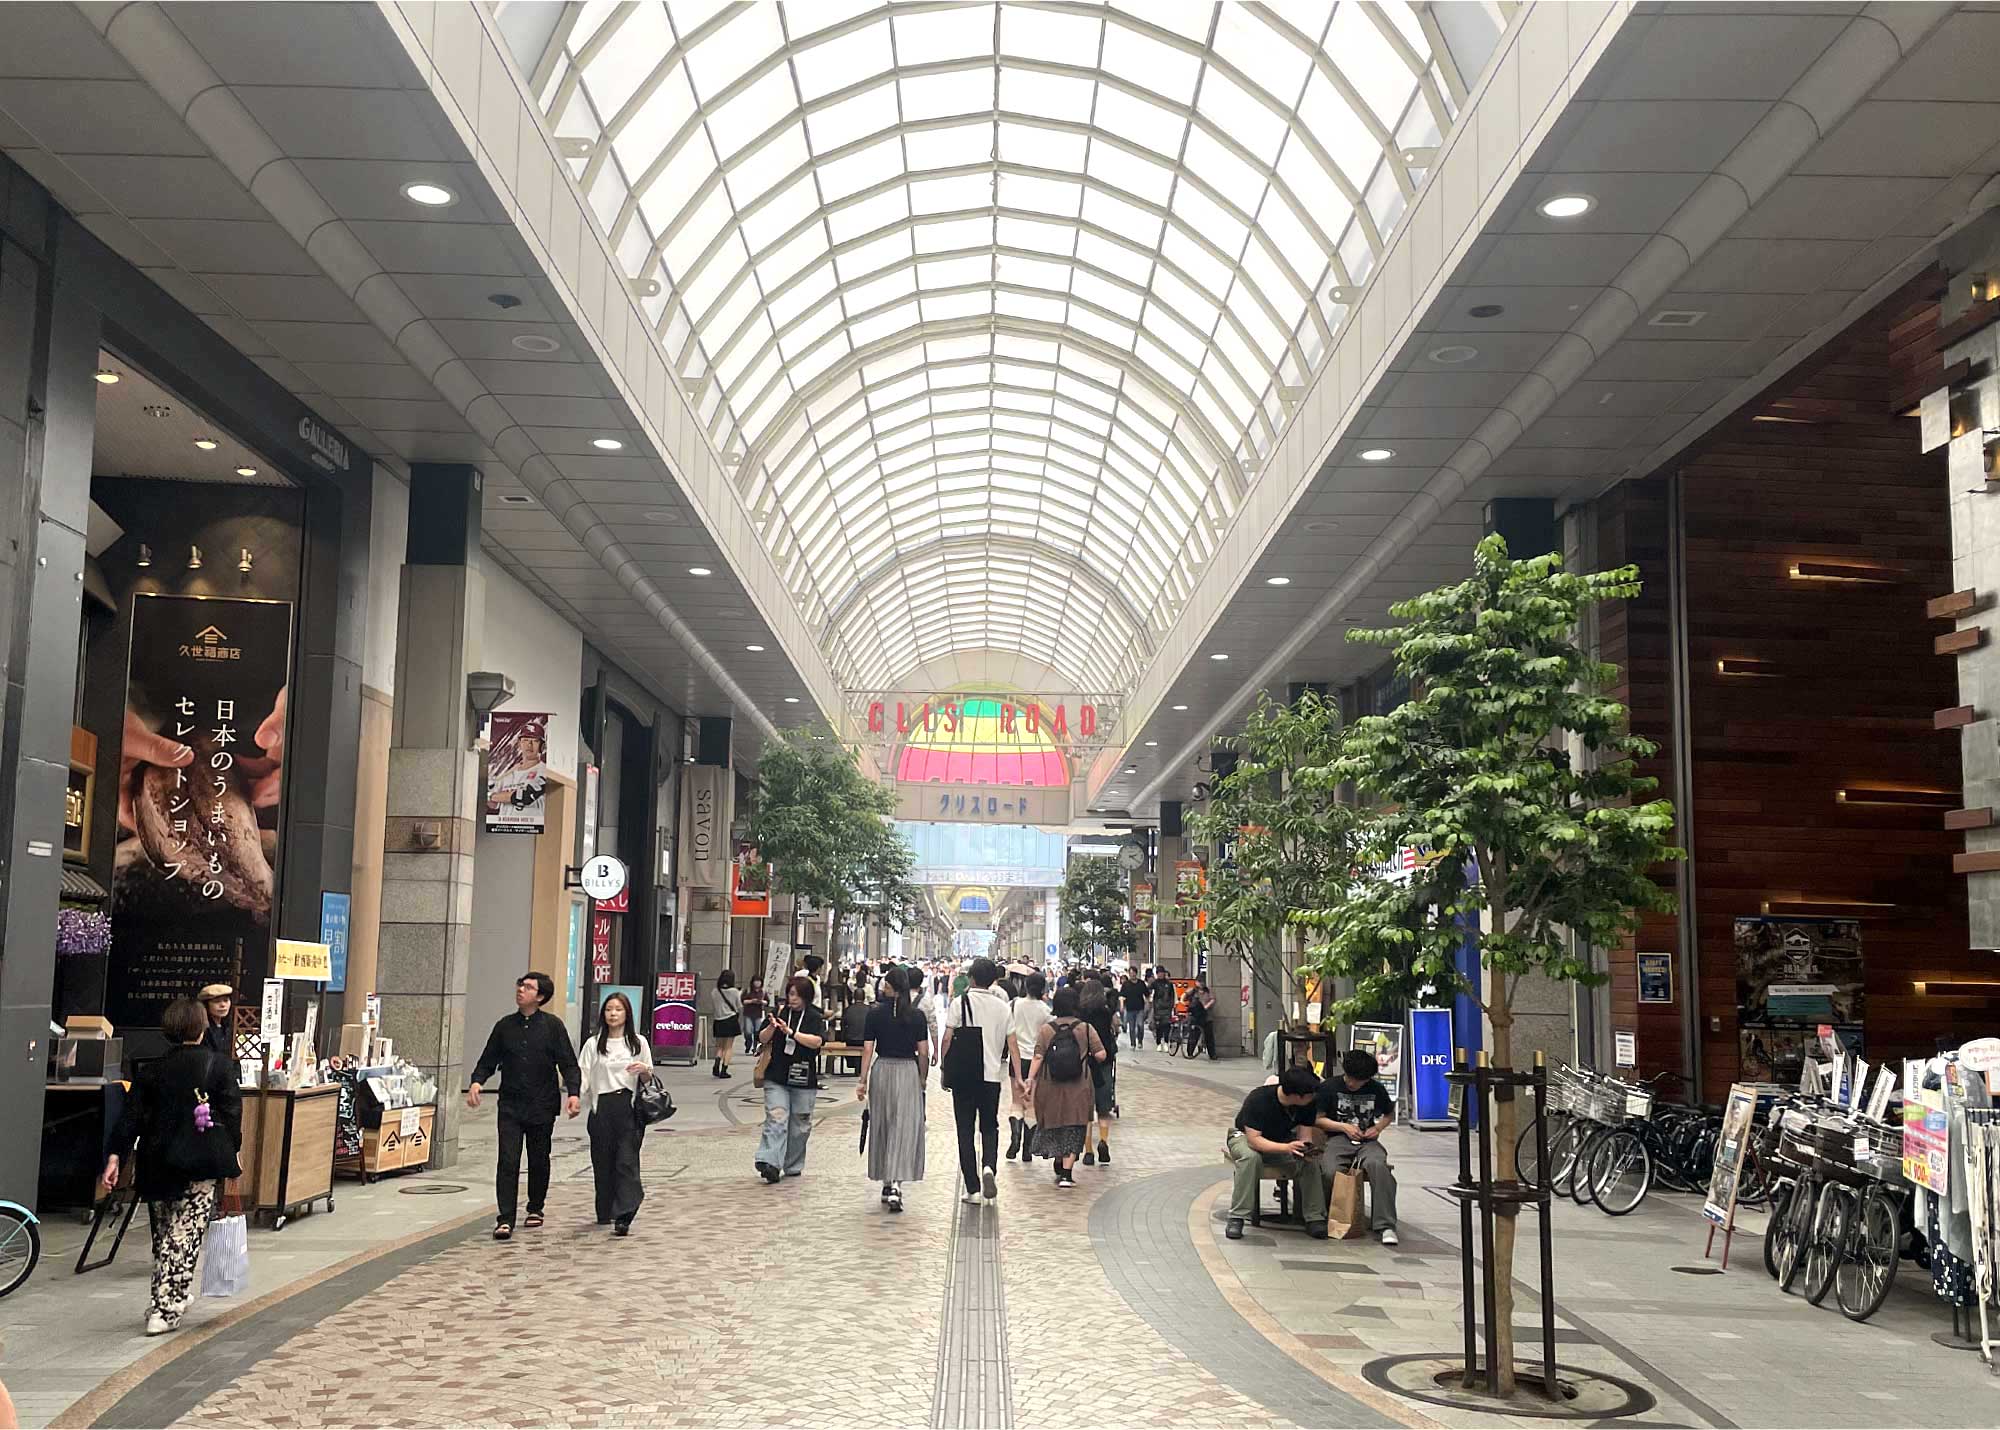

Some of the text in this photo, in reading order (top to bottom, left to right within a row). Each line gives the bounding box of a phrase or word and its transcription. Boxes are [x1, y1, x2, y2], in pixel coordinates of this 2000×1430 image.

[867, 701, 1096, 737] CLIS ROAD
[163, 696, 196, 881] セレクトショップ
[202, 699, 237, 900] 日本のうまいもの
[940, 793, 1028, 816] クリスロード
[695, 789, 712, 862] savon
[584, 879, 621, 888] BILLY'S
[594, 965, 611, 982] OFF
[657, 976, 694, 998] 閉店
[1421, 1055, 1447, 1066] DHC
